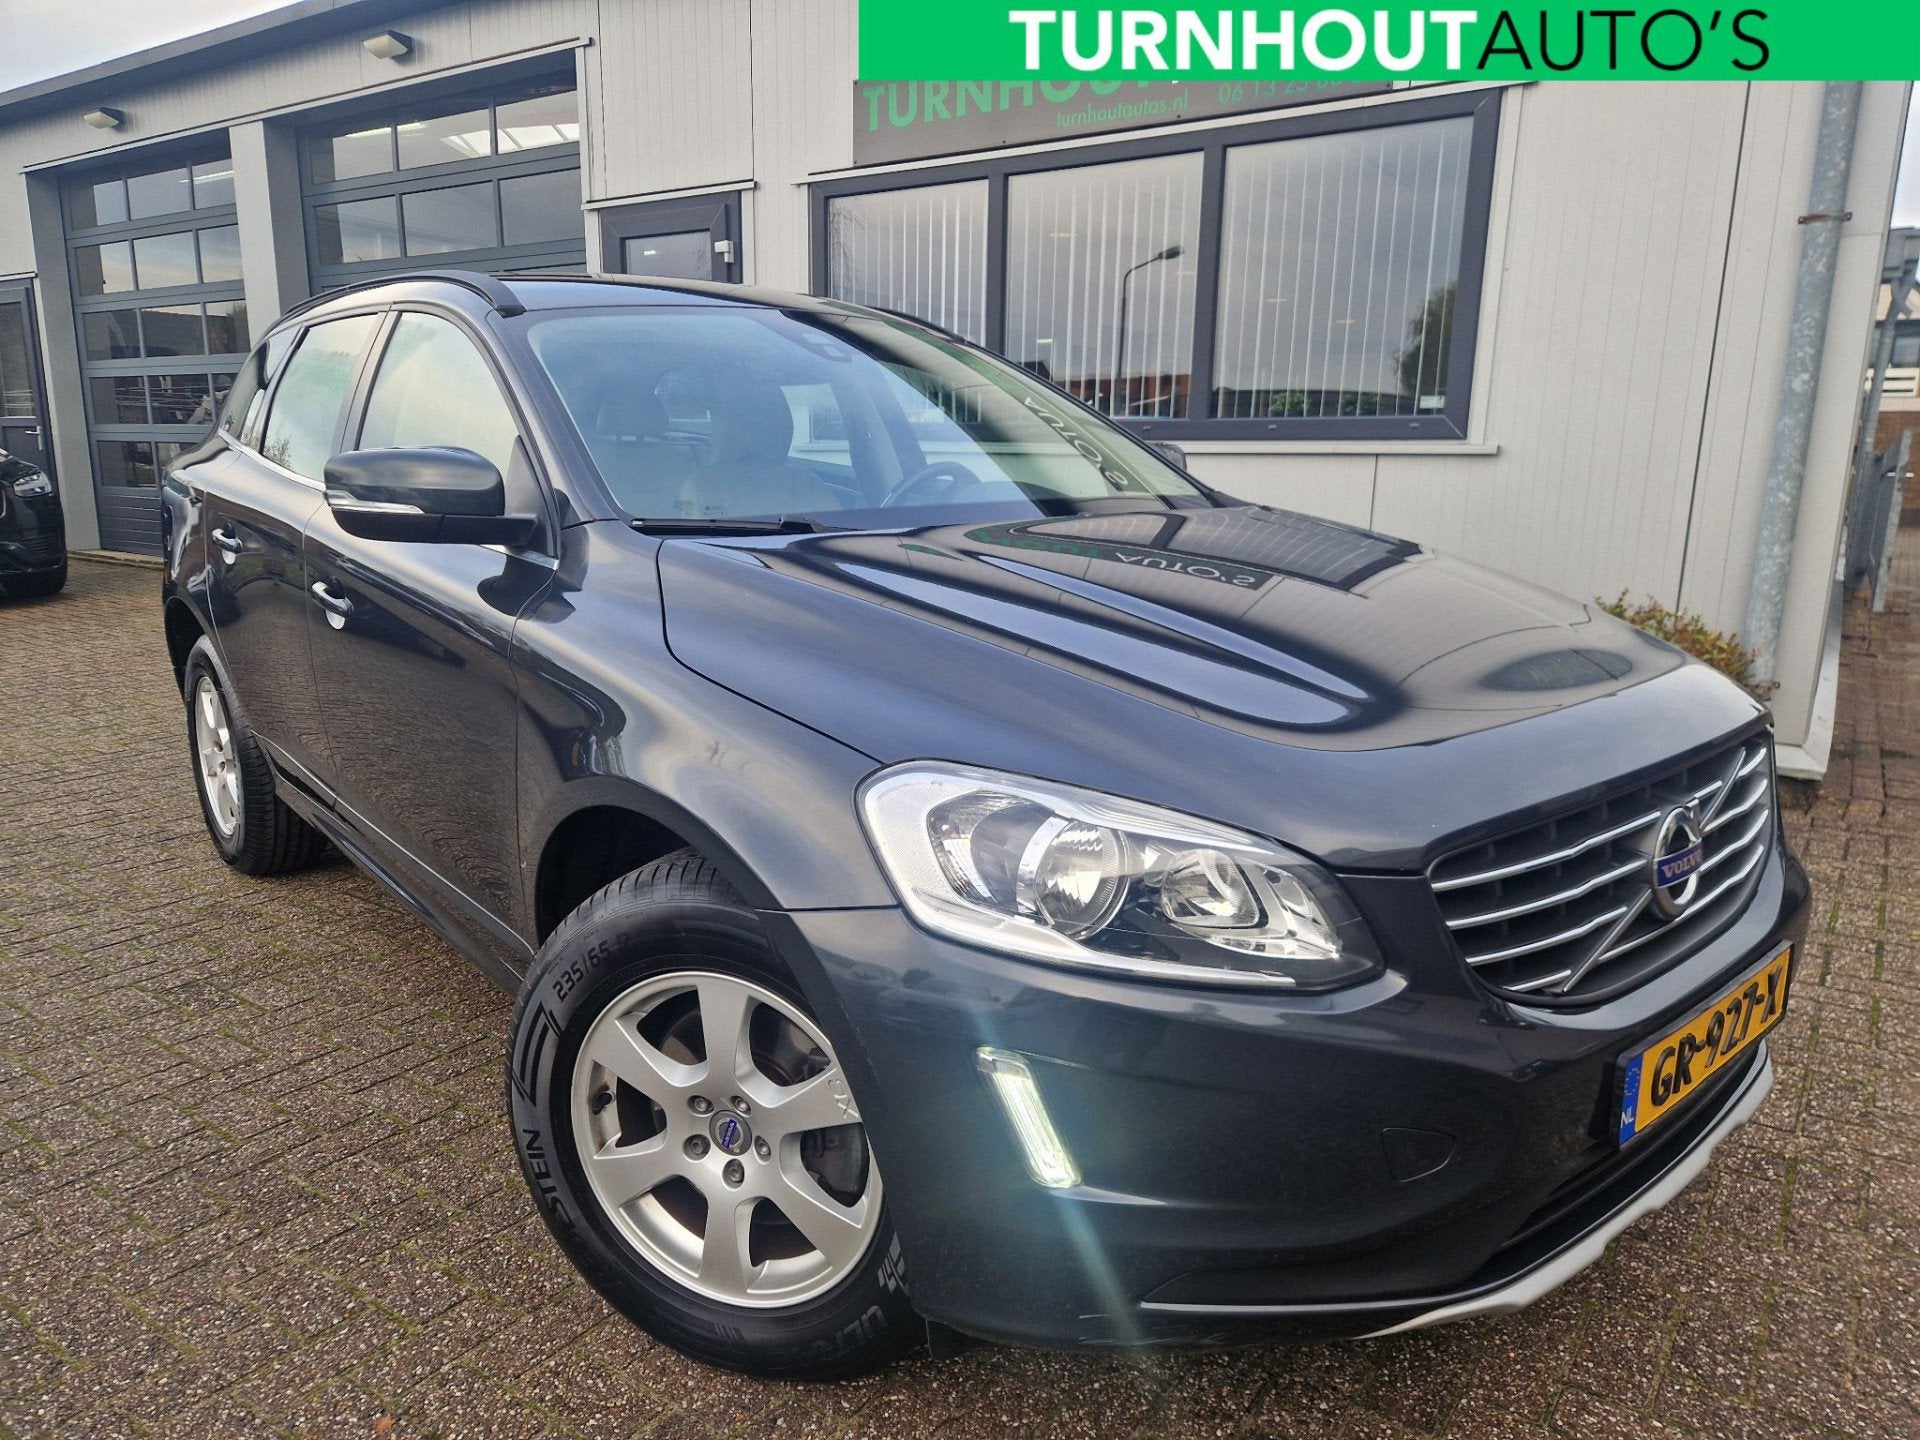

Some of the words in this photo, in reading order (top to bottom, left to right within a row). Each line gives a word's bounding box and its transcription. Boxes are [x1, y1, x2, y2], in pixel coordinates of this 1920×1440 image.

[1055, 86, 1188, 128] turnhoutautos.nl
[1651, 965, 1783, 1107] GR-927-X
[1620, 1106, 1635, 1128] NL
